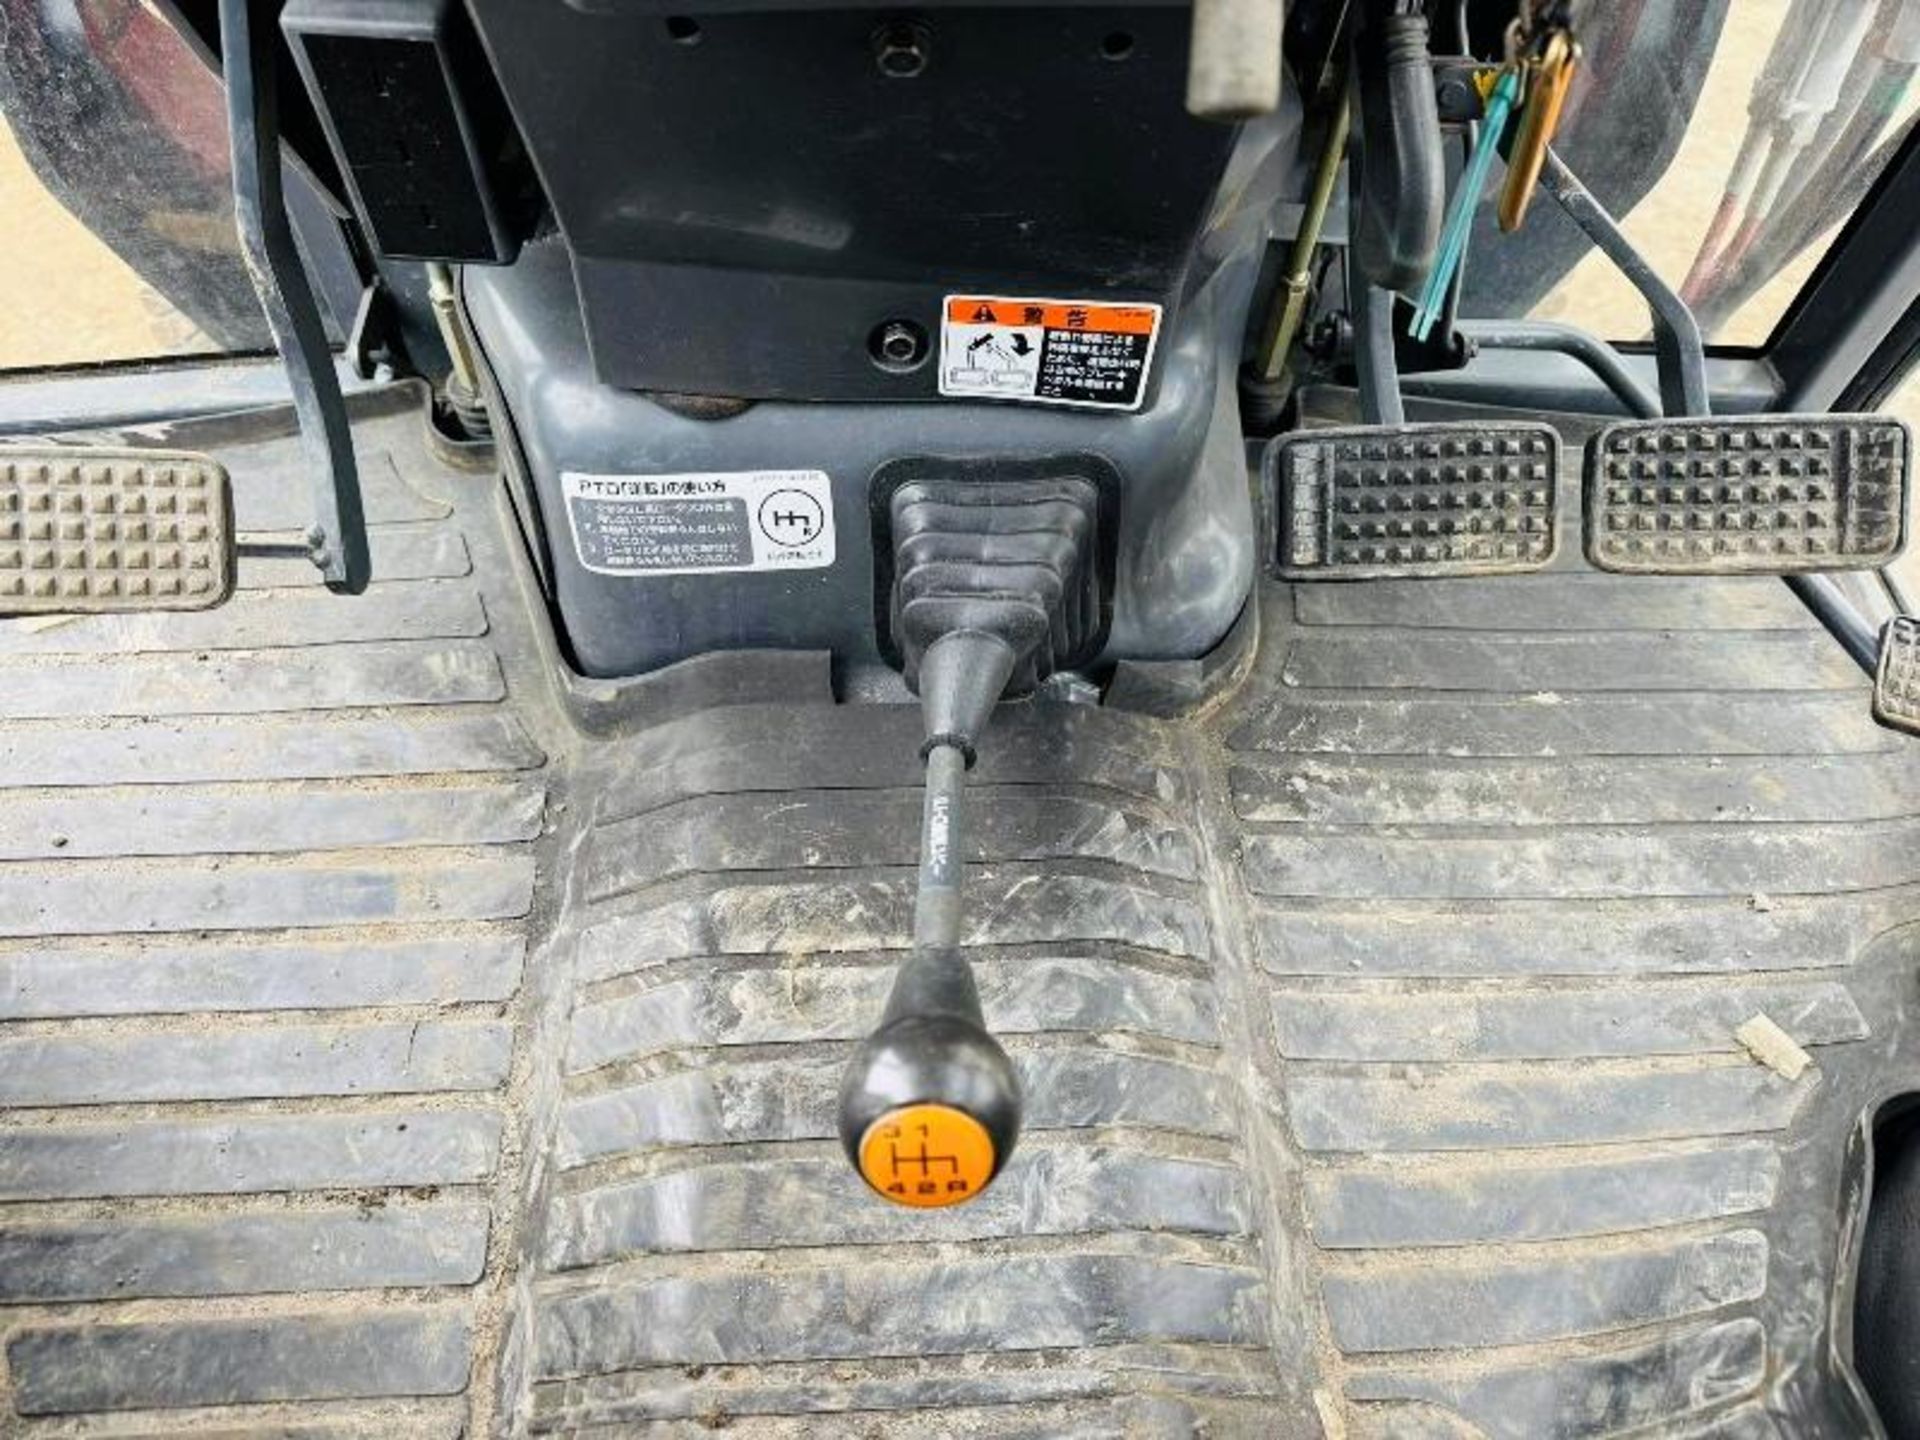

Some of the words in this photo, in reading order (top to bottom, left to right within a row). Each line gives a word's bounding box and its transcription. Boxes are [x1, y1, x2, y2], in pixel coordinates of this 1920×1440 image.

[1023, 306, 1087, 327] 警告
[916, 1124, 928, 1138] 1
[887, 1183, 905, 1194] 4
[917, 1182, 936, 1194] 2
